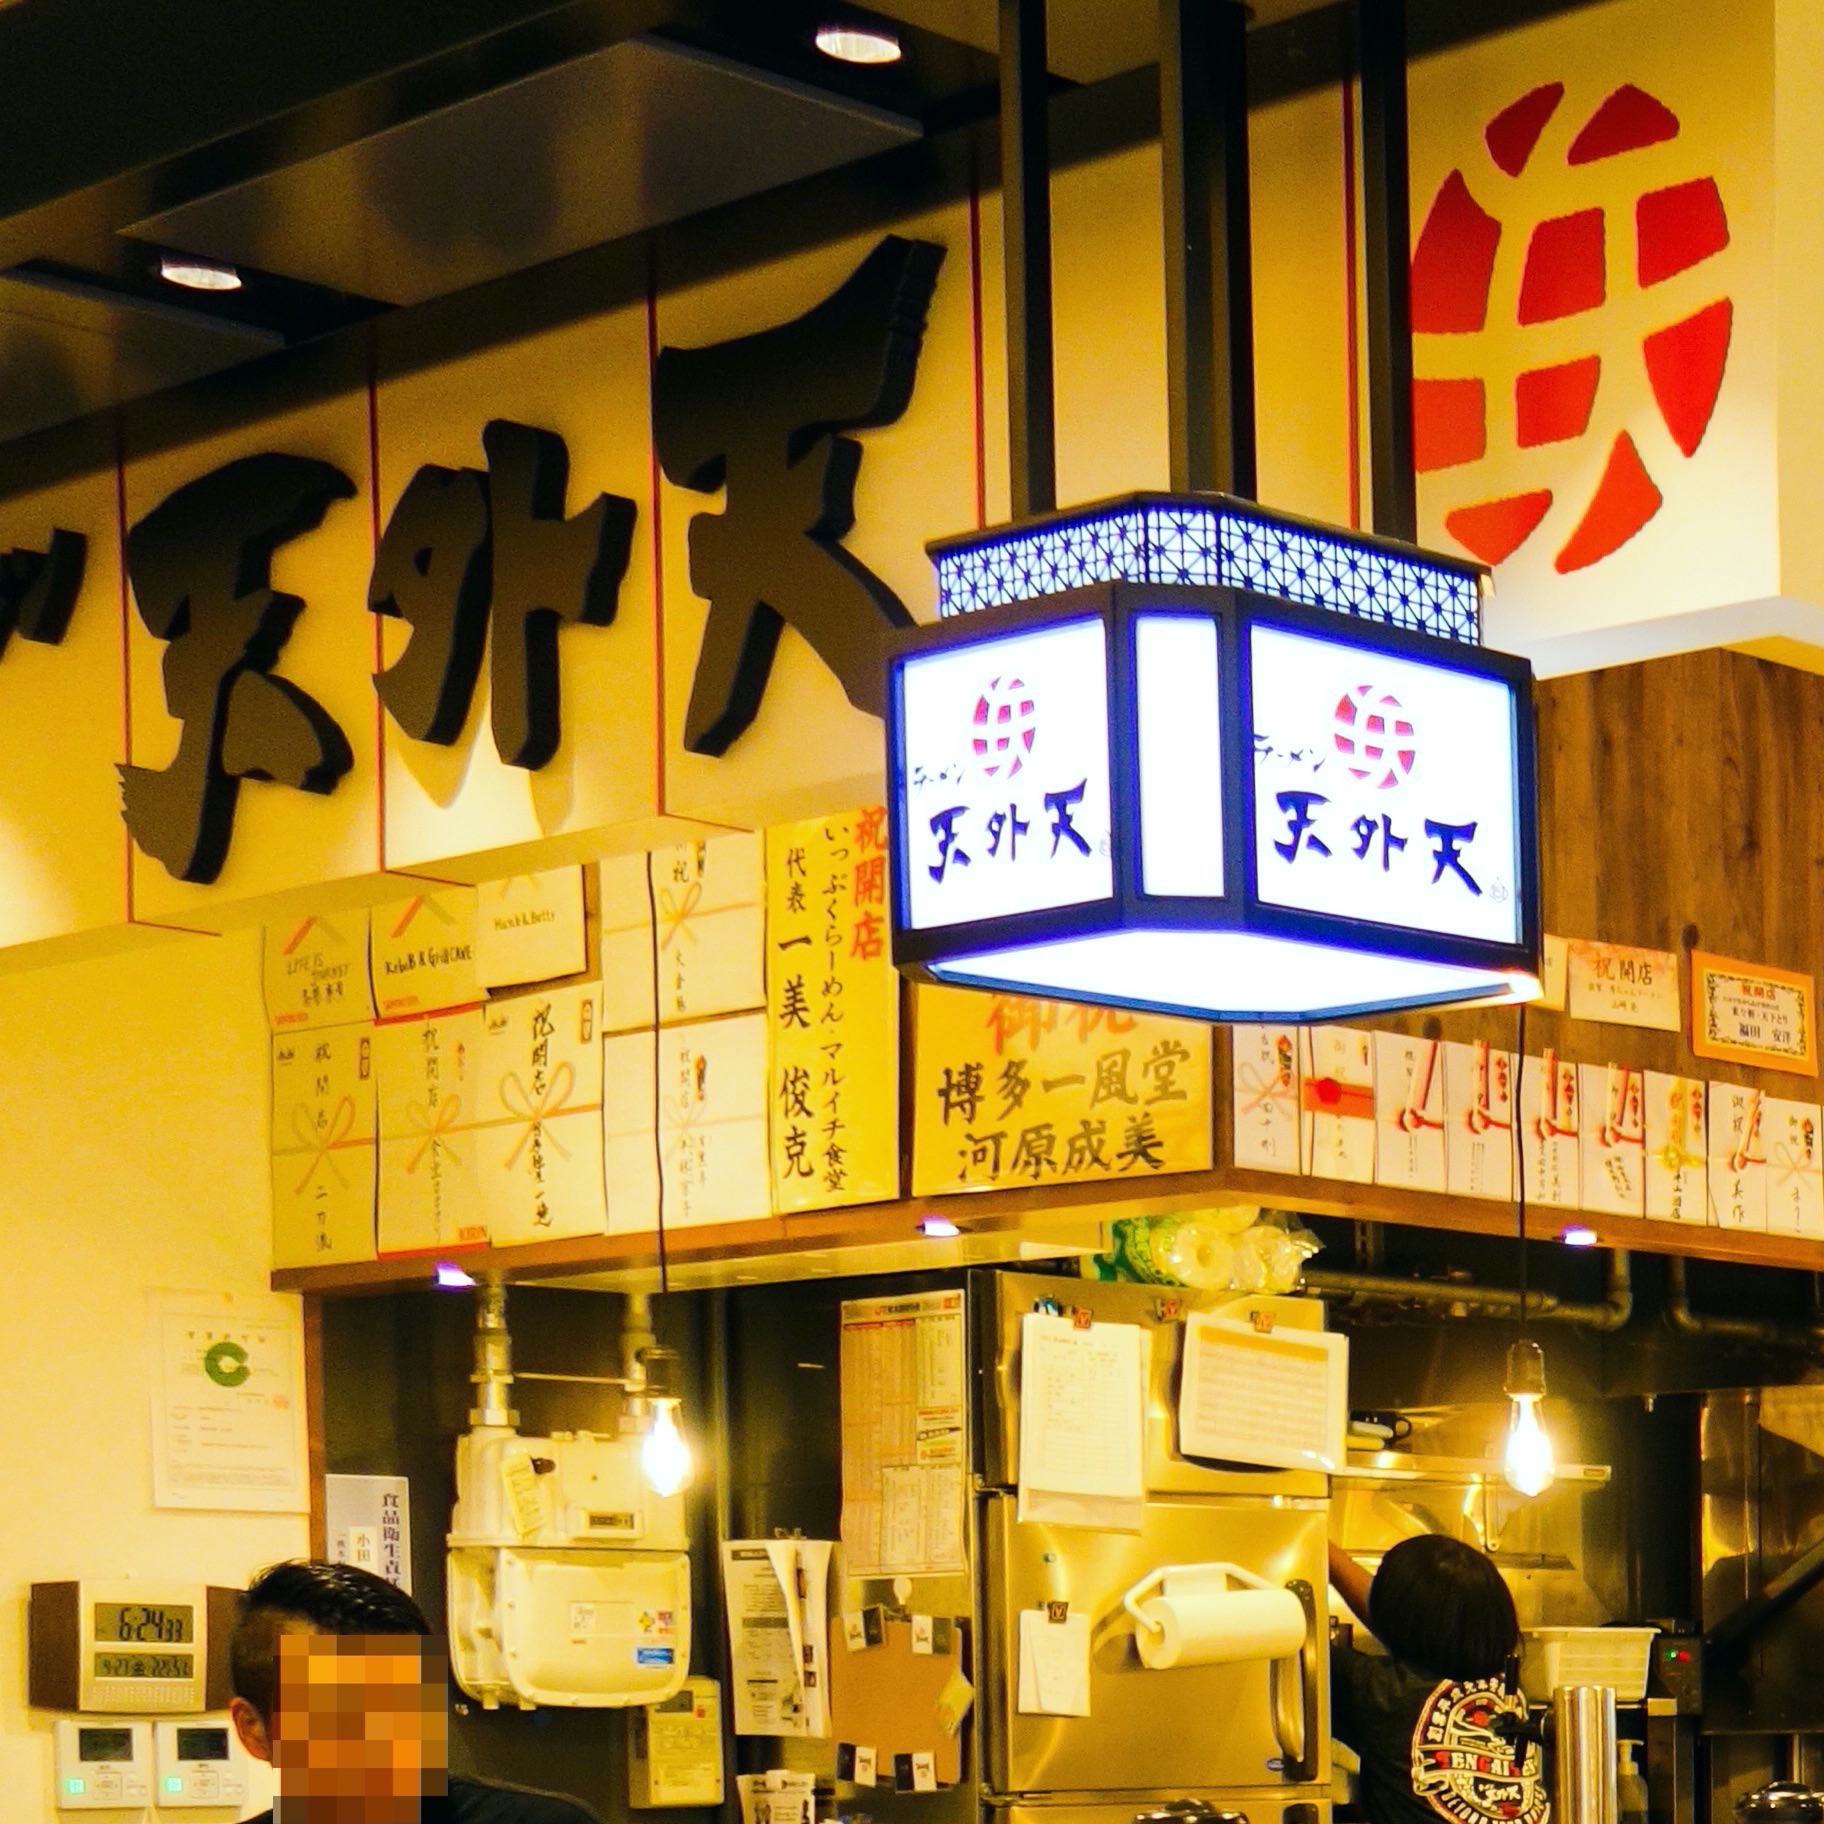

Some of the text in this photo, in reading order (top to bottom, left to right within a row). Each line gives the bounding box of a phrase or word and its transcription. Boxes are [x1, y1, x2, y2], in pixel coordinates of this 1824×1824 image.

[909, 762, 968, 792] ラーメン
[1252, 732, 1329, 774] ラーメン
[927, 776, 1095, 886] 天外天
[1272, 788, 1485, 898] 天外天
[785, 847, 808, 913] 代表
[850, 803, 888, 962] 祝開店
[1591, 955, 1654, 987] 祝開店
[936, 1039, 1193, 1127] 博多一風堂
[956, 1110, 1167, 1182] 河原成美
